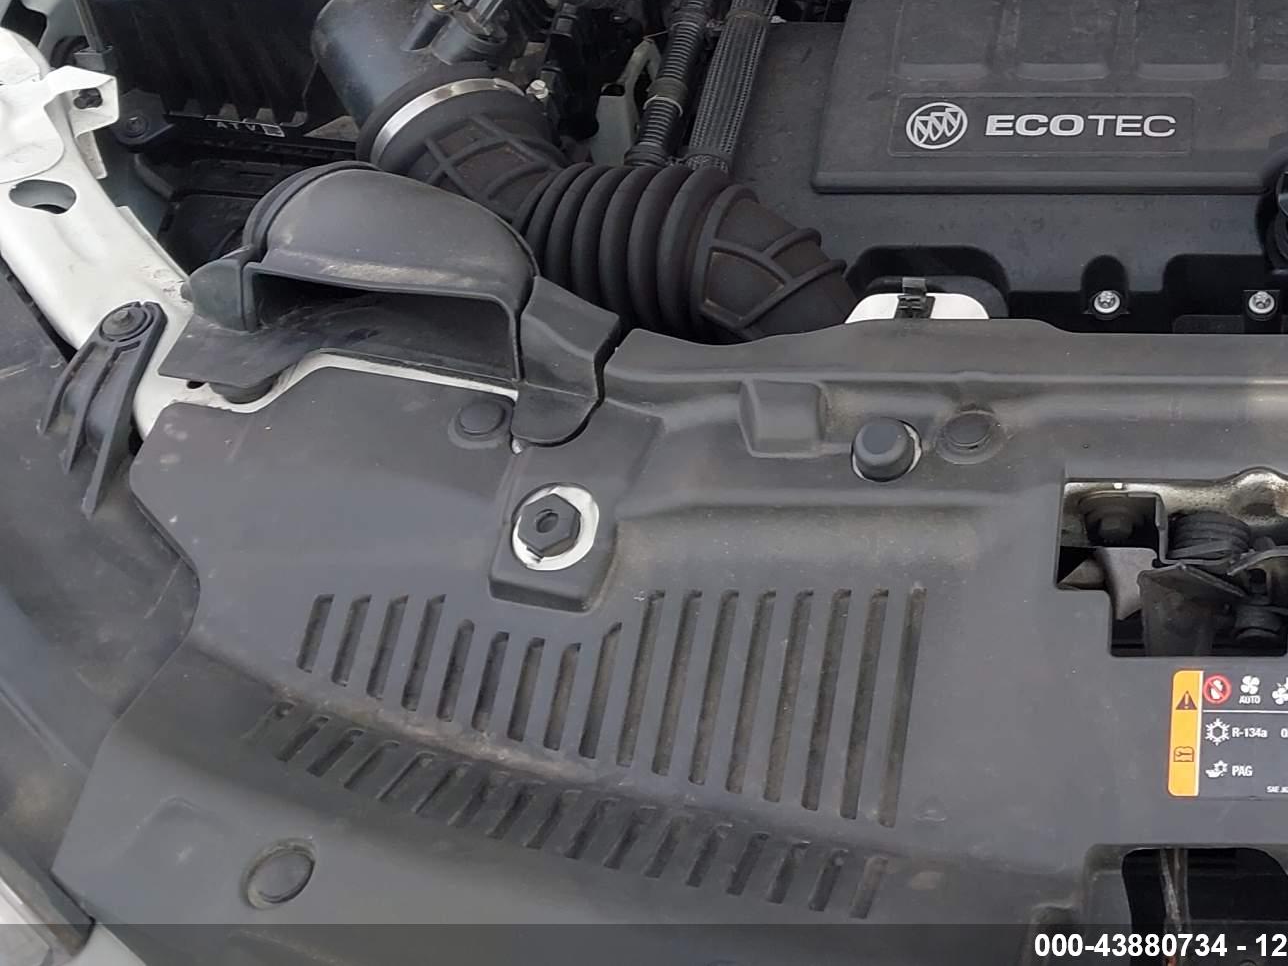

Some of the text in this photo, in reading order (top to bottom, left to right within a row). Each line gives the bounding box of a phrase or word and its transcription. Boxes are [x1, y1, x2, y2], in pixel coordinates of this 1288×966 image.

[985, 114, 1176, 137] ECOTEC
[1239, 695, 1261, 704] AUTO
[1231, 727, 1268, 738] R-134a
[1231, 765, 1253, 777] PAG
